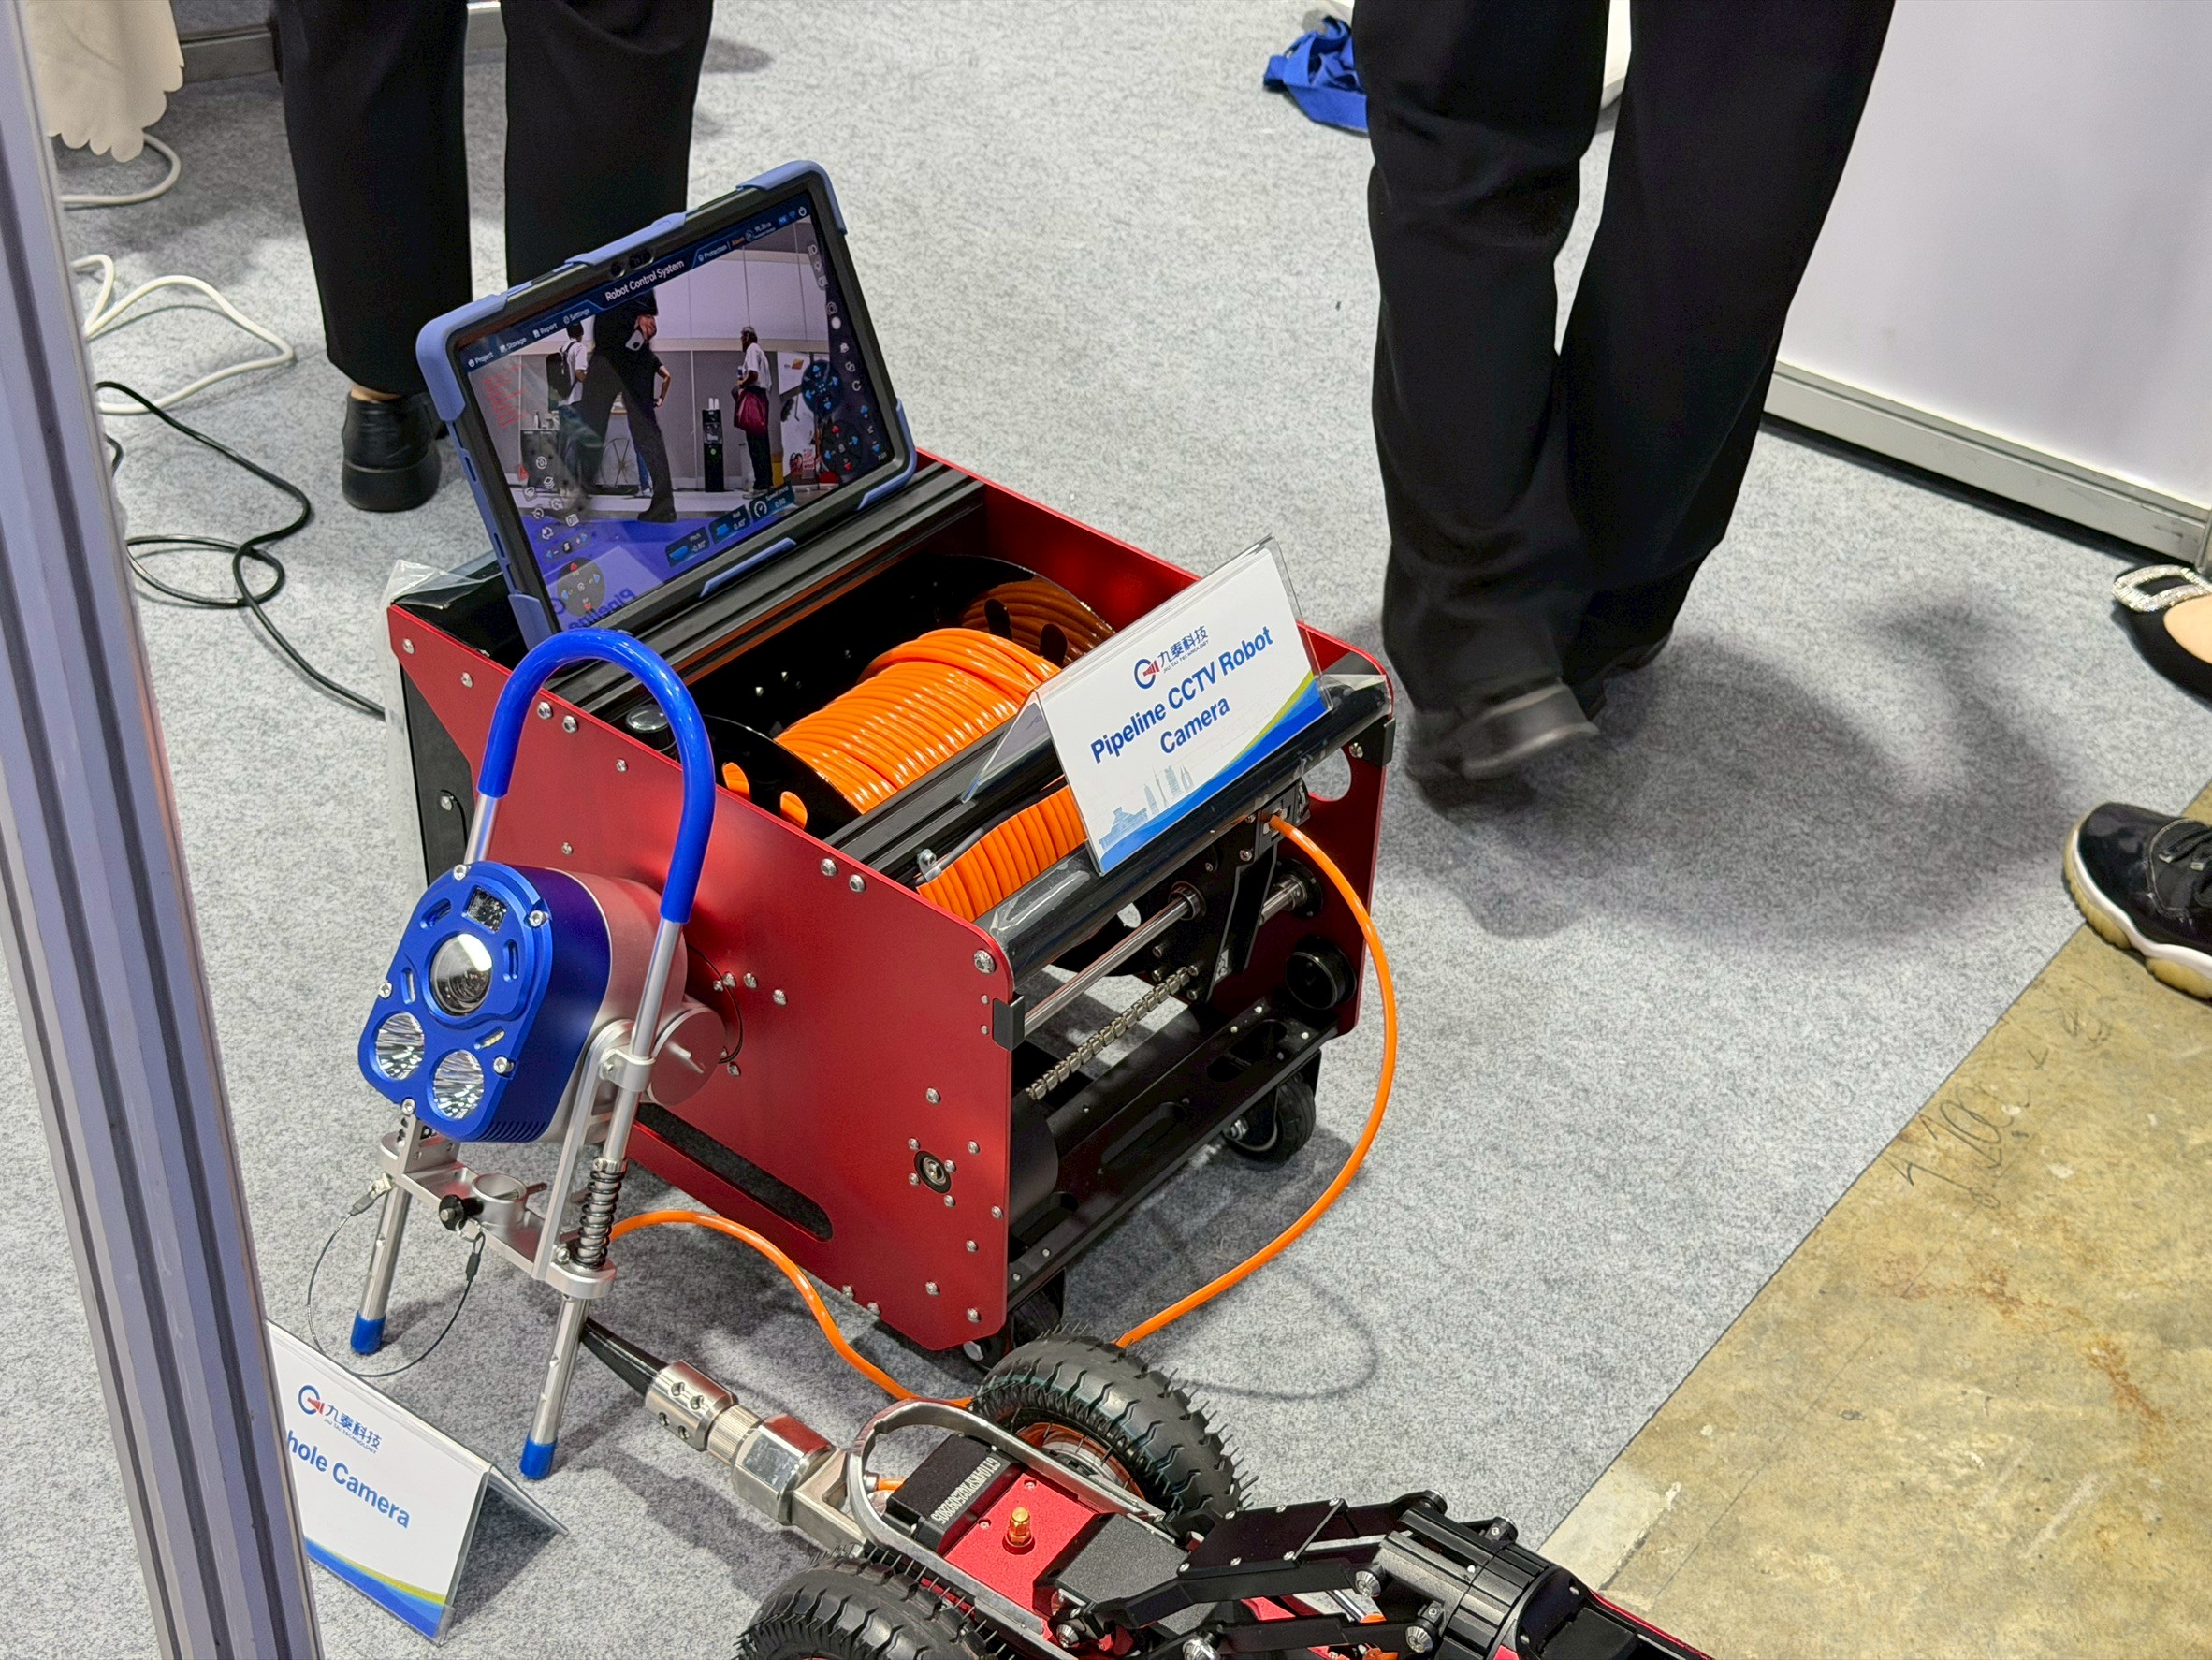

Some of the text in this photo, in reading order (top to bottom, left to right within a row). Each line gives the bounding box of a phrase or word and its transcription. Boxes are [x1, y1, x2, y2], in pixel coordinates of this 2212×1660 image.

[705, 244, 728, 259] Protection
[604, 259, 685, 302] Robot Control System
[474, 307, 591, 365] Project Storage Report Settings
[1157, 625, 1209, 668] 九泰科技
[1090, 626, 1274, 764] Pipeline CCTV Robot
[1159, 697, 1231, 754] Camera
[325, 1404, 383, 1450] 九泰科技
[332, 1462, 412, 1530] Camera
